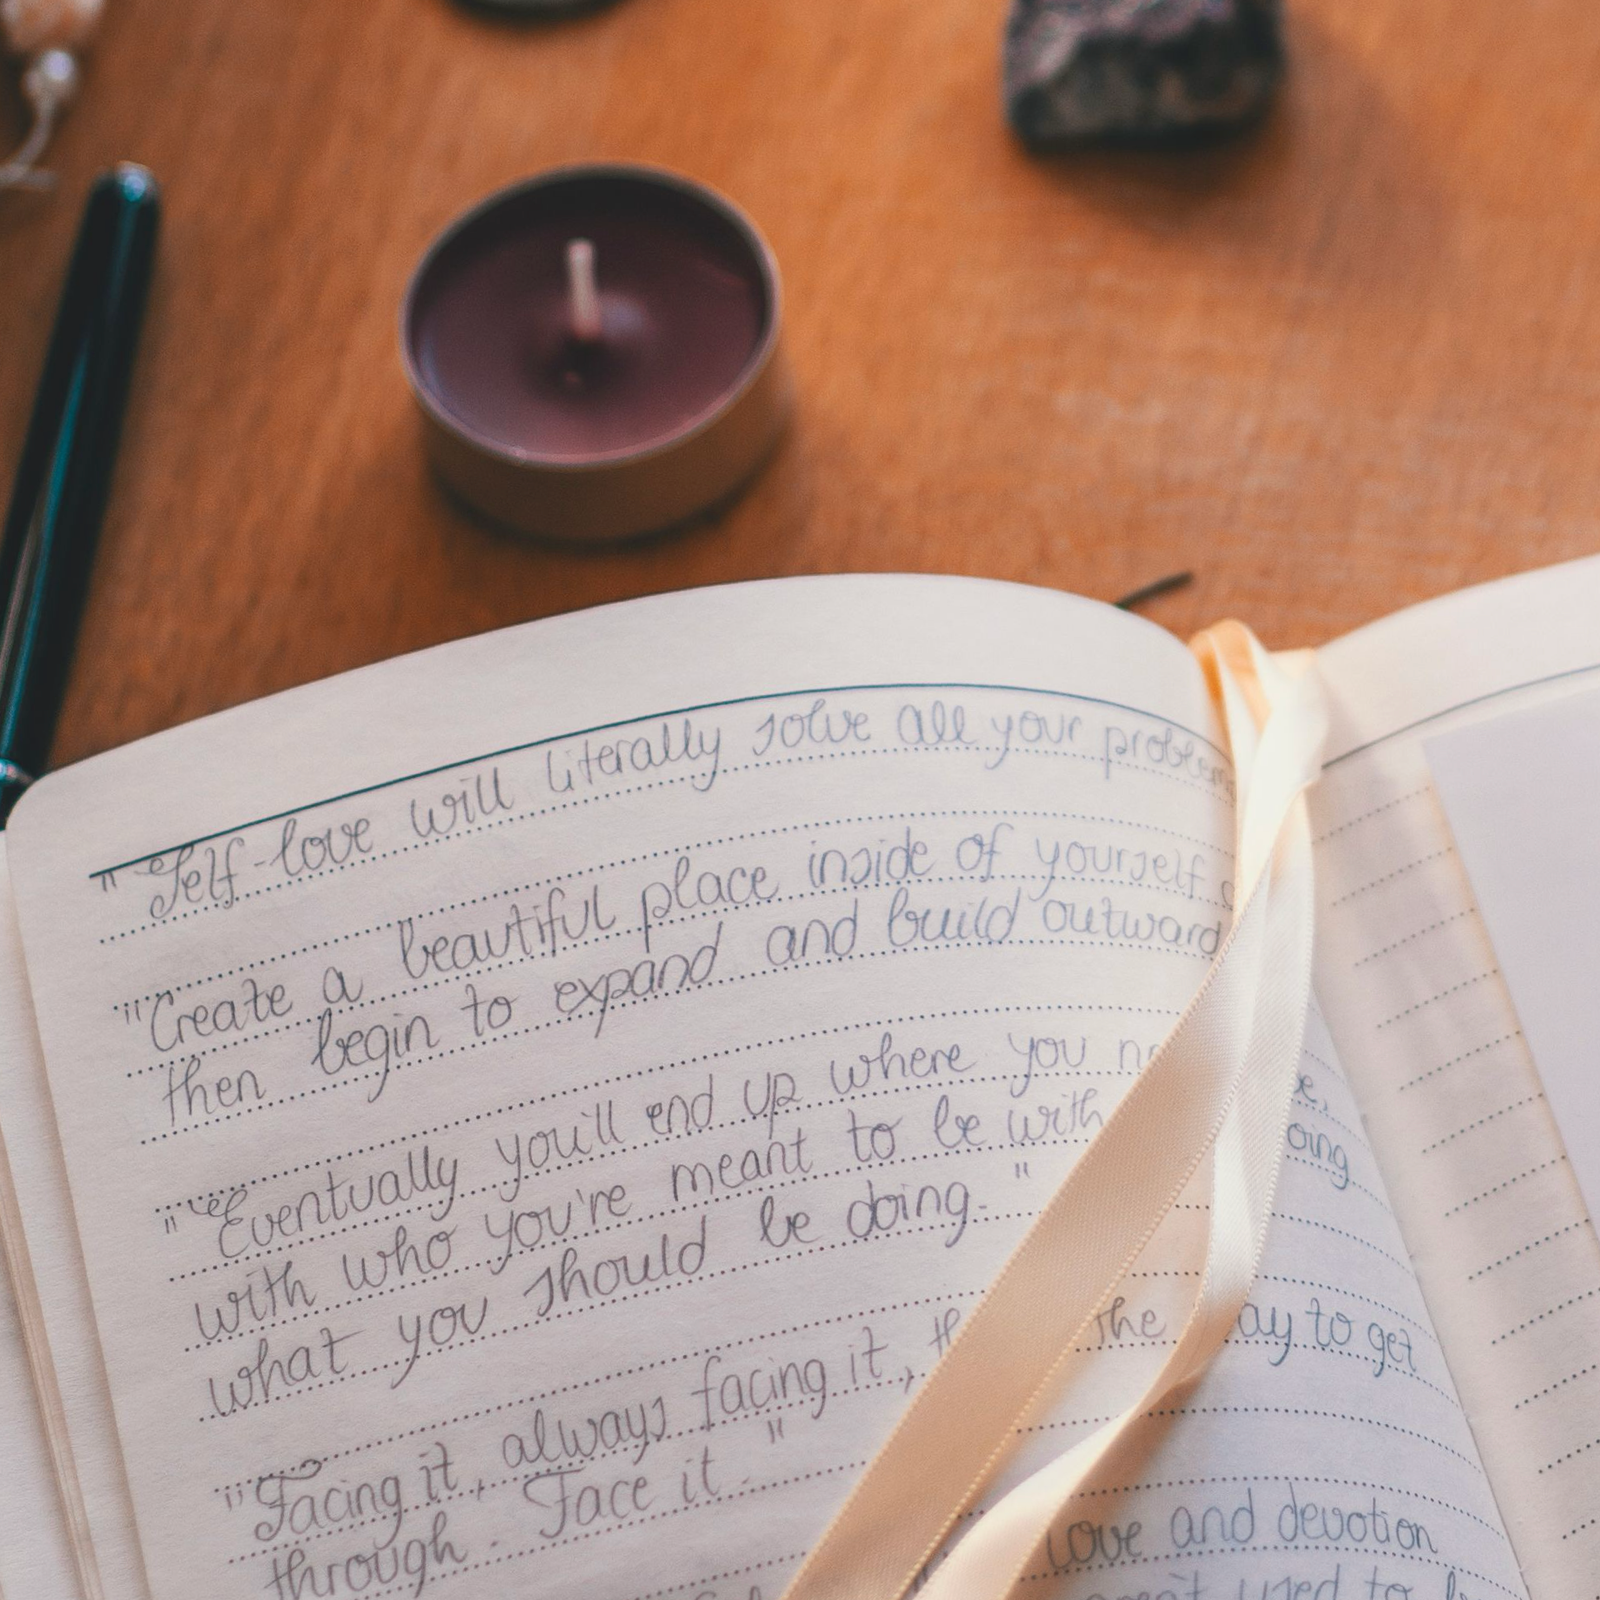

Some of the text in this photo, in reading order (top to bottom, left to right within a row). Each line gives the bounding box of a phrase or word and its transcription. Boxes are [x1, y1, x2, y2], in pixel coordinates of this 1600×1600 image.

[410, 766, 514, 839] will
[547, 719, 721, 793] literally
[752, 699, 872, 758] solve
[898, 700, 976, 747] all
[990, 703, 1083, 769] your
[323, 966, 363, 1006] a
[400, 884, 616, 979] beautiful
[642, 856, 780, 952] place
[809, 826, 935, 888] inside
[956, 821, 1014, 895] of
[1034, 837, 1206, 901] yourself
[163, 1059, 267, 1127] then
[311, 1008, 440, 1103] begin
[462, 982, 514, 1031] to
[554, 921, 723, 1039] expand
[765, 897, 858, 967] and
[887, 886, 1022, 945] build
[646, 1073, 716, 1136] end
[743, 1071, 805, 1140] up
[829, 1030, 979, 1096] where
[1008, 1030, 1088, 1098] you
[195, 1085, 1350, 1342] with who you're meant to be with oing
[207, 1326, 367, 1419] what
[391, 1294, 488, 1390] you
[523, 1214, 707, 1319] should
[759, 1193, 820, 1250] be
[501, 1393, 669, 1467] always
[691, 1354, 827, 1433] facing
[1237, 1301, 1293, 1367] ay
[1305, 1296, 1354, 1348] to
[1367, 1320, 1418, 1378] get
[523, 1465, 656, 1539] Face
[1171, 1486, 1257, 1549] and
[1277, 1481, 1439, 1555] devotion
